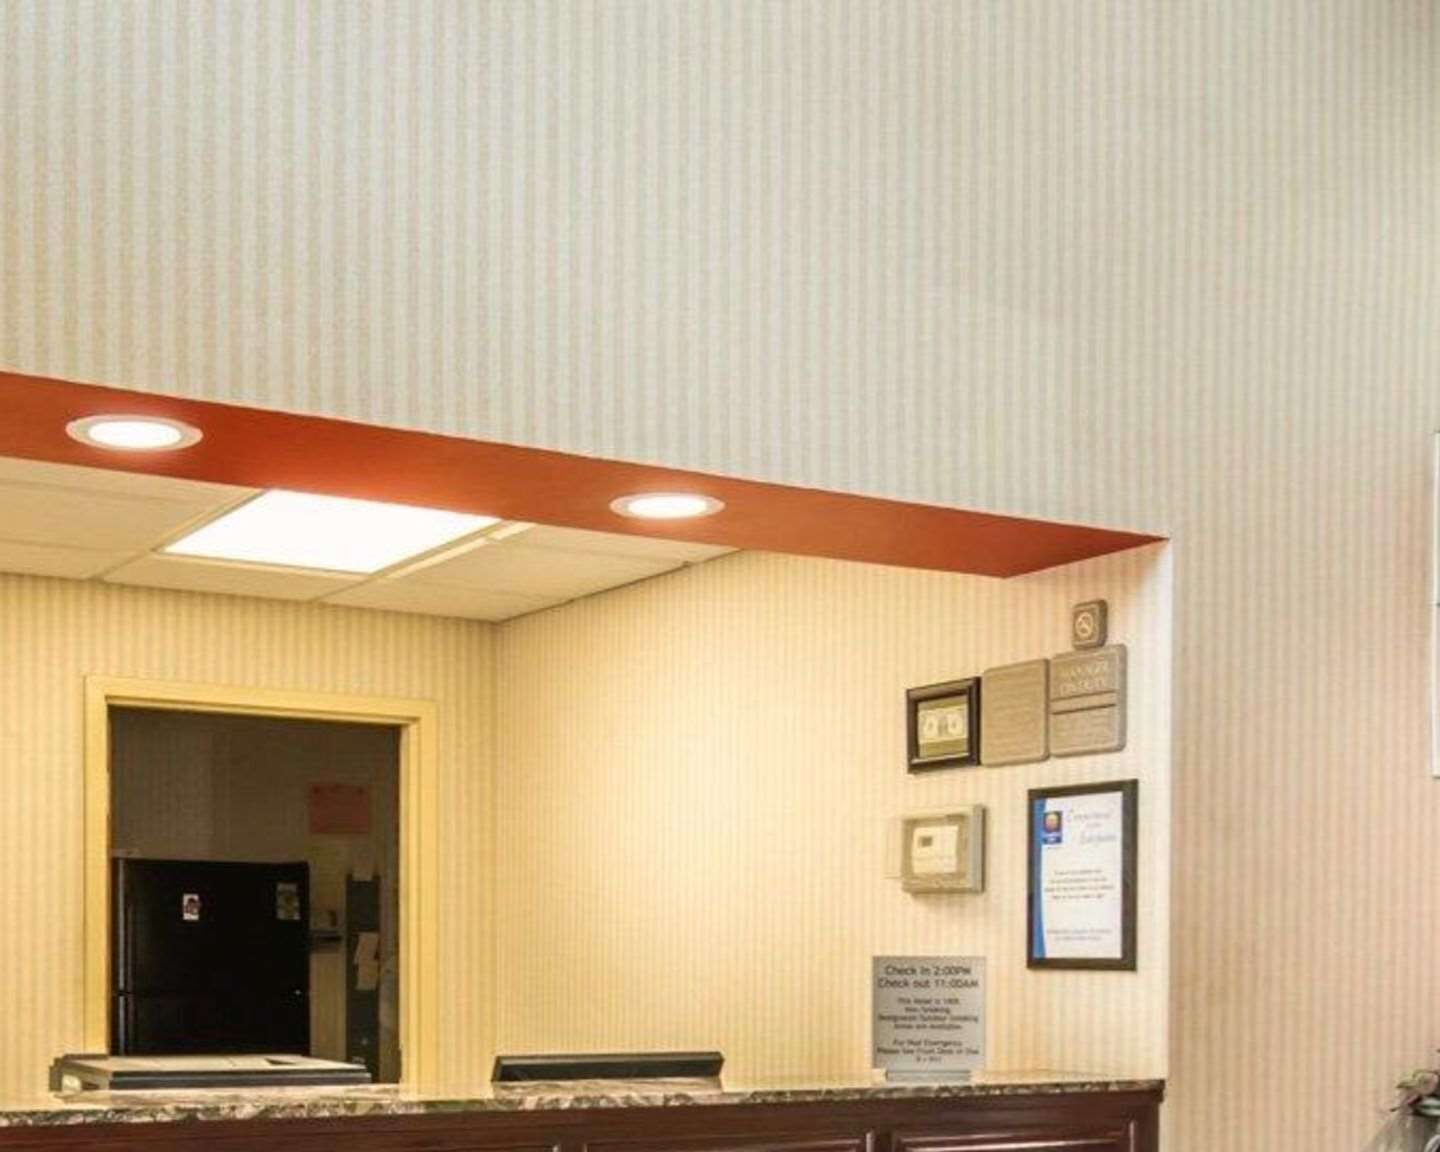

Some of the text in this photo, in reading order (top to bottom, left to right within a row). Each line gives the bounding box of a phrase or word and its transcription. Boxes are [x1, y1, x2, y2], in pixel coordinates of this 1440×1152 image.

[885, 965, 916, 976] Check
[934, 965, 971, 977] 2:00PM
[877, 978, 979, 989] Check out 11:00AM
